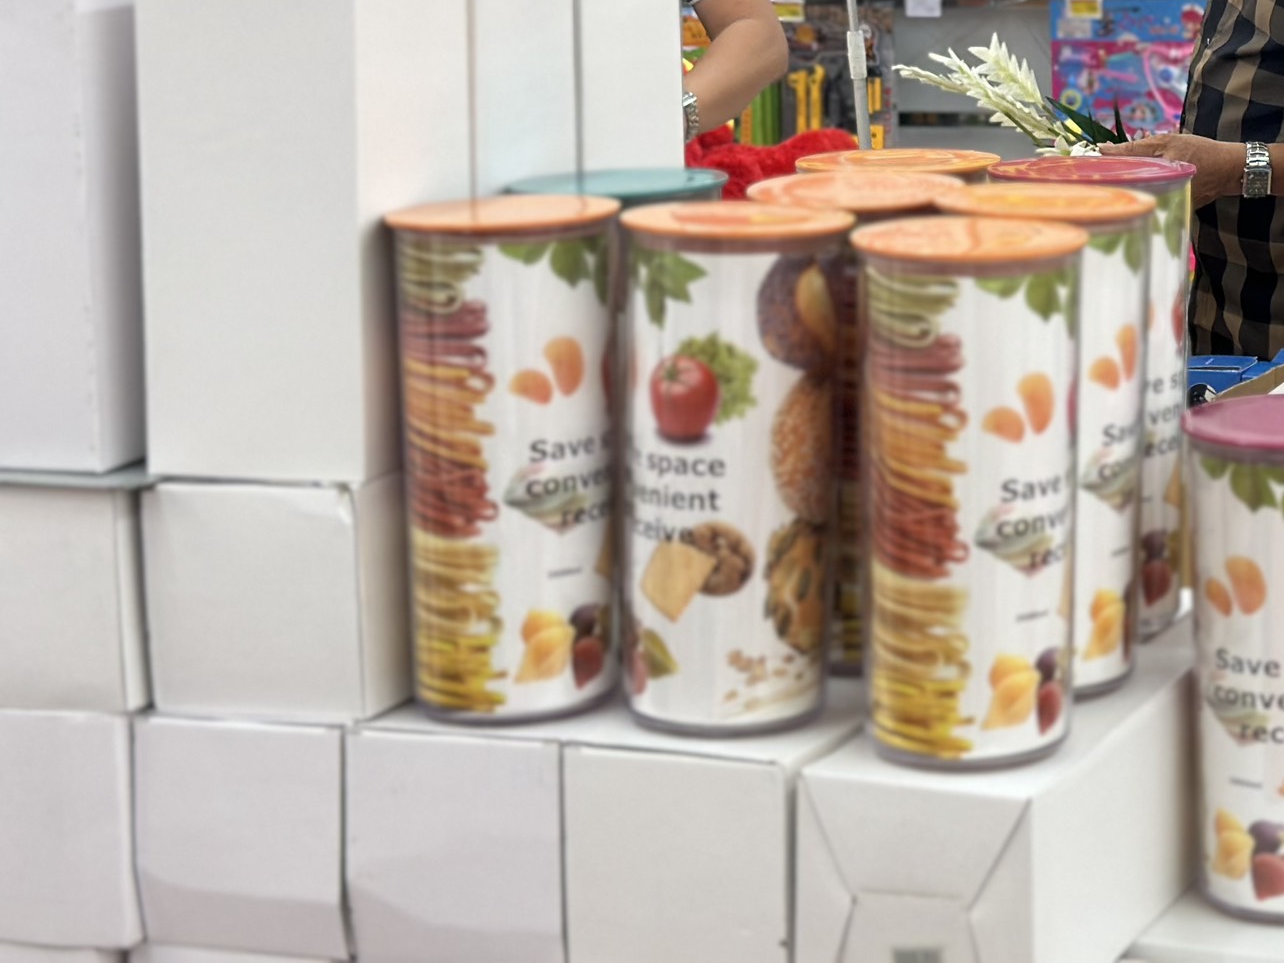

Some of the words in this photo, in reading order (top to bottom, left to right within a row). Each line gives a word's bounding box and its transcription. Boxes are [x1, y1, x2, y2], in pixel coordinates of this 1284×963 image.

[529, 436, 596, 463] Save
[647, 452, 726, 479] space
[1000, 475, 1061, 504] Save
[1215, 647, 1281, 678] Save
